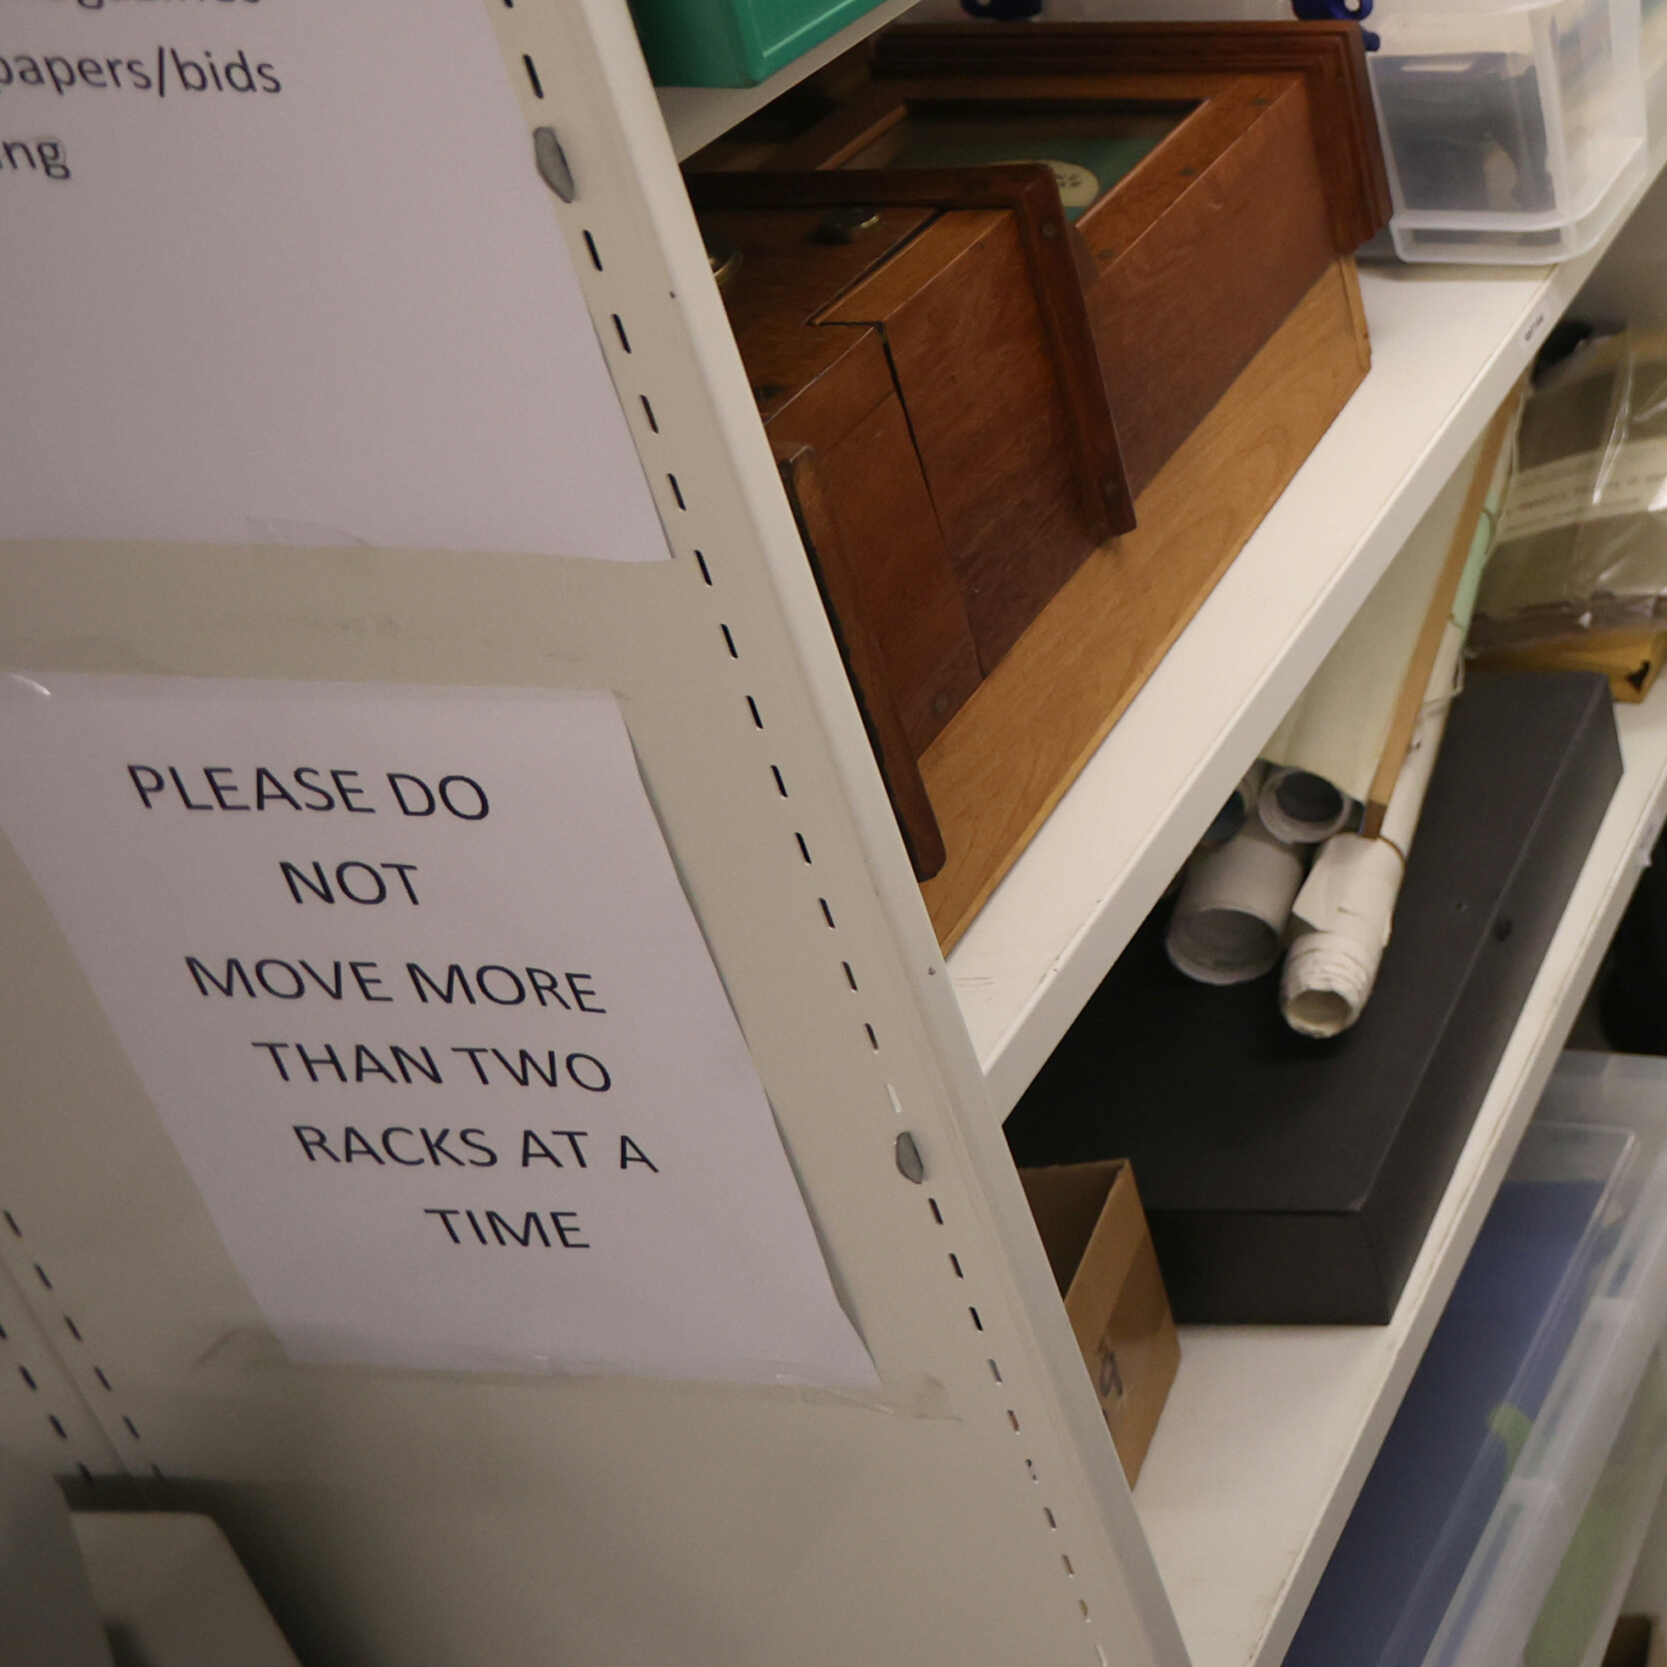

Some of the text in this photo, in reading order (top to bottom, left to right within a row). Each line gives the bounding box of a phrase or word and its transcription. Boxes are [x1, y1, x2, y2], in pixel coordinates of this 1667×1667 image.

[128, 763, 490, 821] PLEASE DO
[280, 861, 419, 906] NOT
[184, 955, 607, 1014] MOVE MORE
[251, 1041, 612, 1093] THAN TWO
[292, 1124, 659, 1173] RACKS AT A
[424, 1208, 590, 1250] TIME
